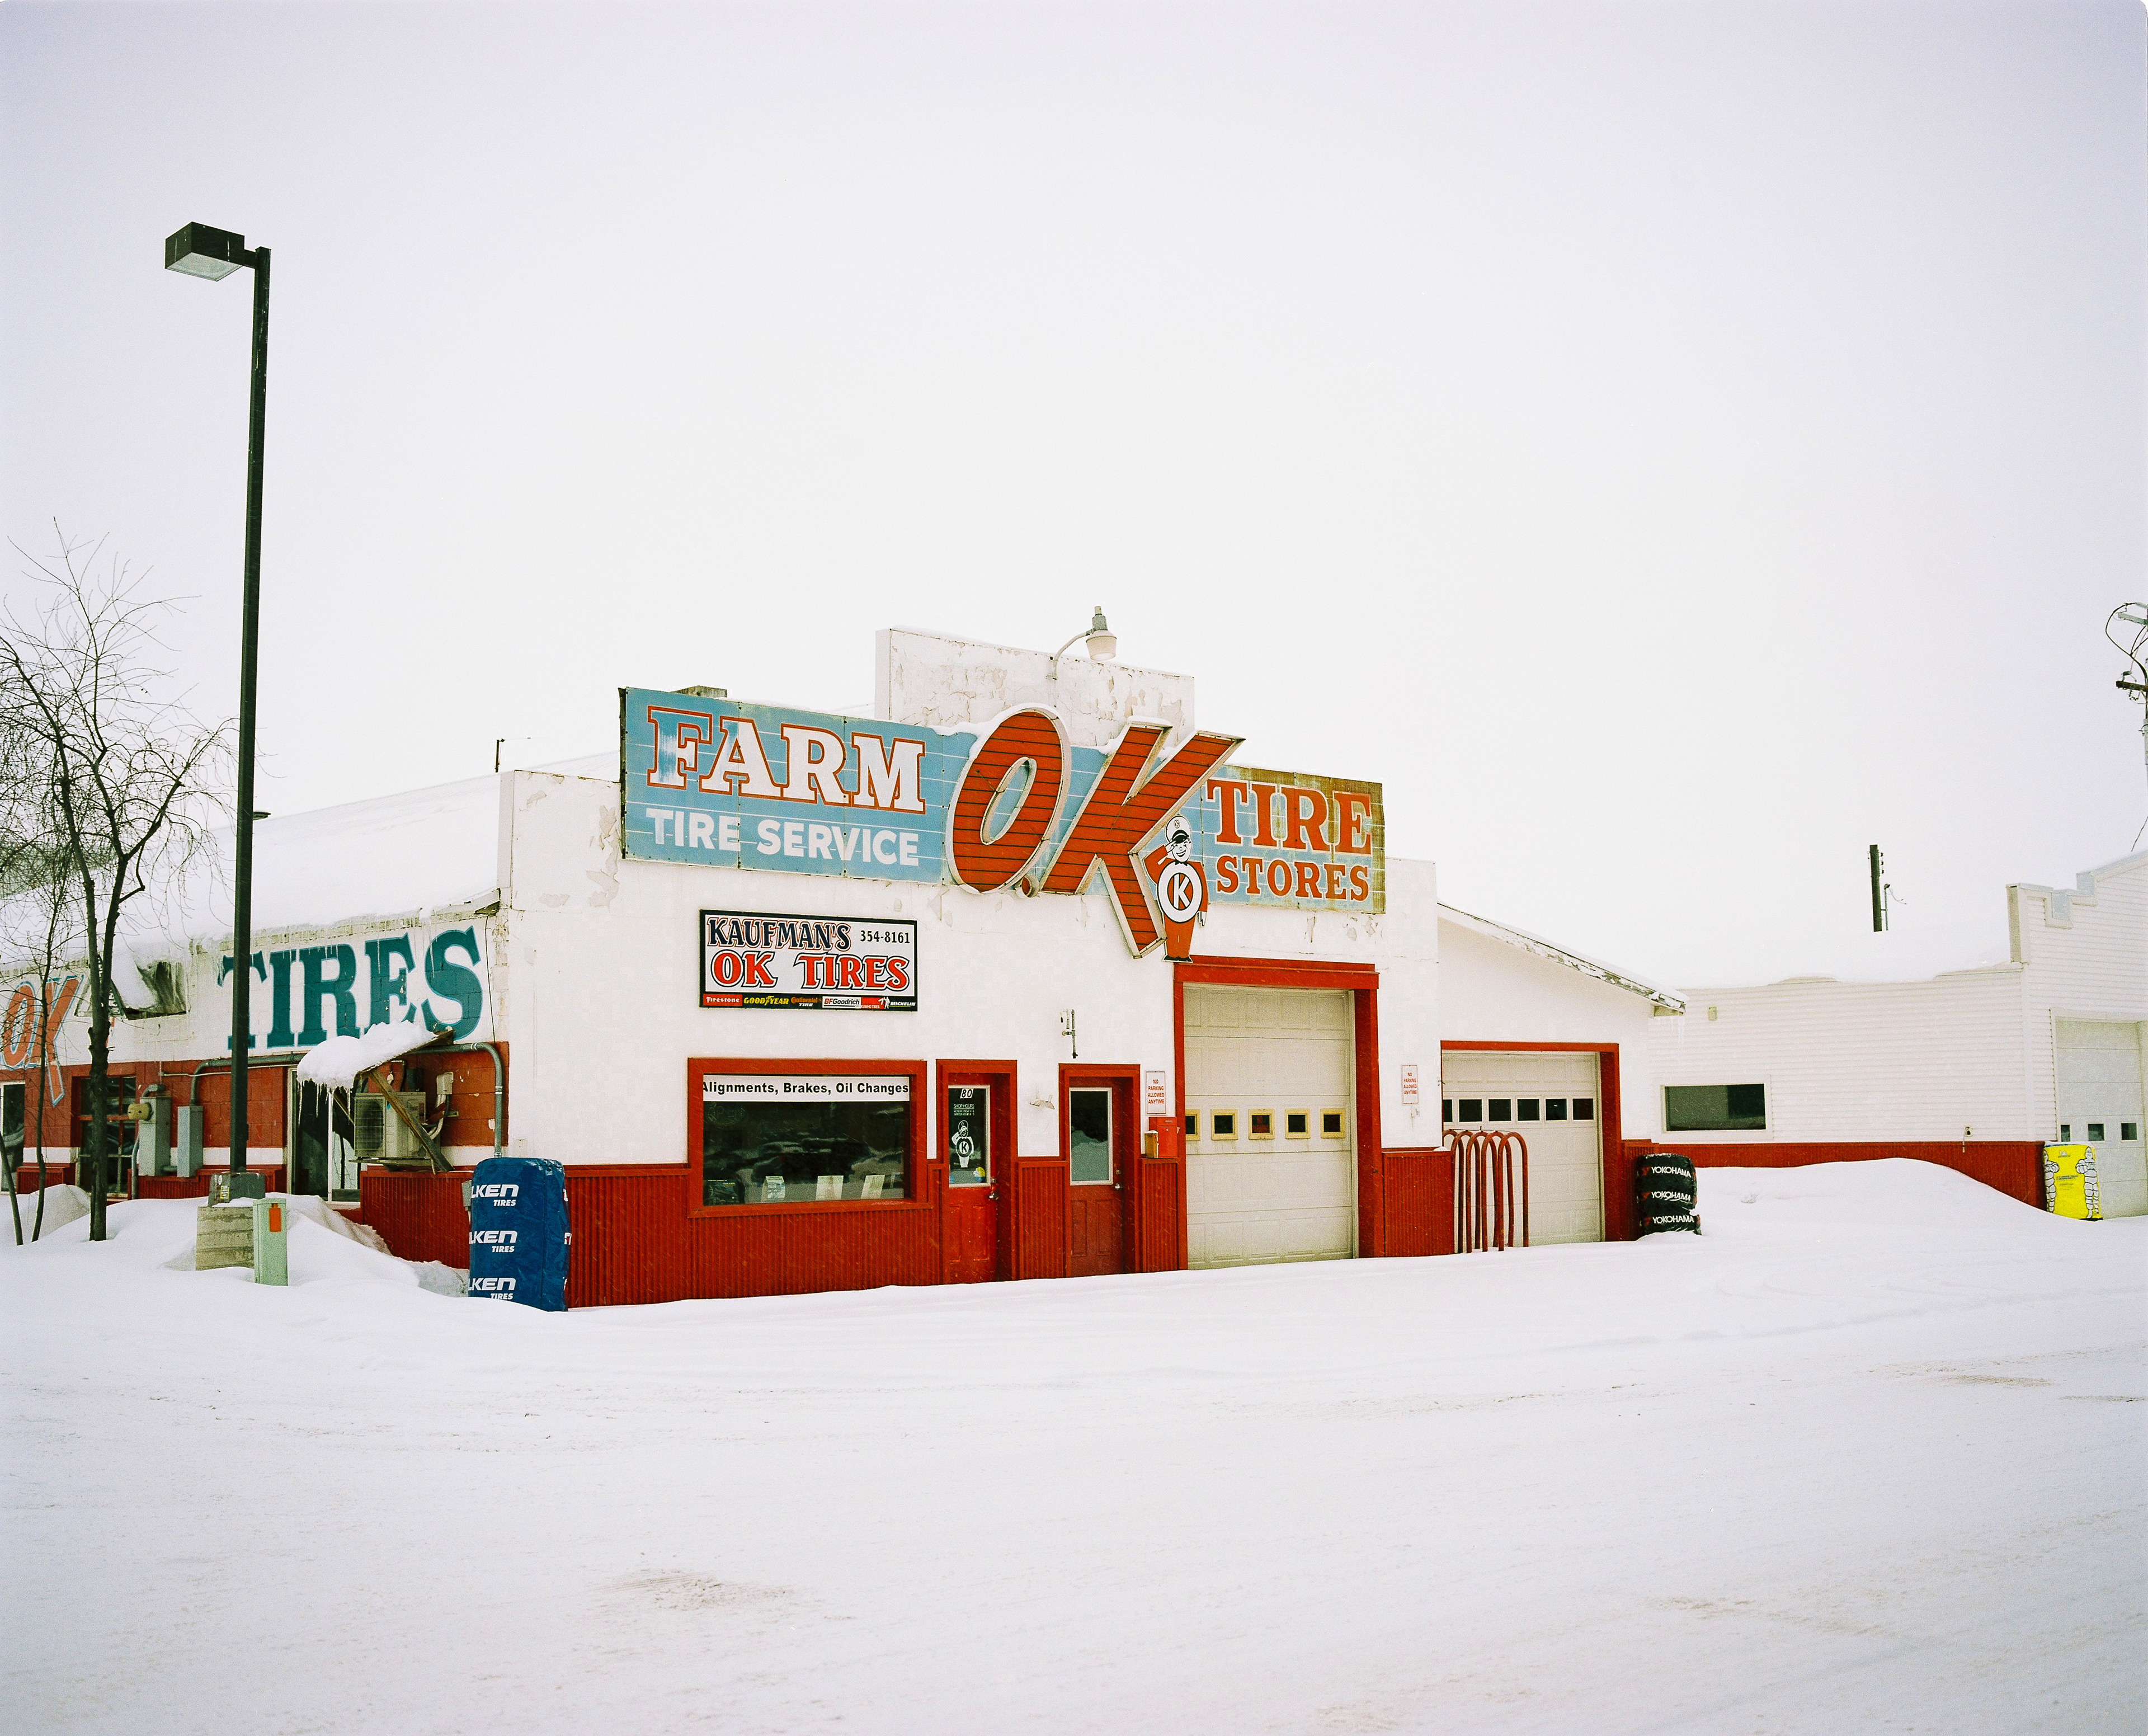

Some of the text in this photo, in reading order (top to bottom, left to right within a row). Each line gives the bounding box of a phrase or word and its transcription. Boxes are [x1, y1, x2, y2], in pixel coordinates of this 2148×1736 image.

[647, 705, 925, 815] FARM
[1206, 779, 1372, 855] TIRE
[646, 808, 919, 866] TIRE SERVICE
[1216, 855, 1369, 902] STORES
[707, 918, 910, 951] KAUFMAN'S 354-8161
[217, 926, 483, 1051] TIRES
[710, 949, 910, 992] OK TIRES
[743, 996, 789, 1005] GOODYEAR
[1, 974, 84, 1107] OK
[703, 1082, 909, 1095] Alignments, Brakes, Oil Changes
[962, 1089, 972, 1098] 80
[1651, 1166, 1692, 1178] YOKOHAMA
[1651, 1191, 1690, 1202] YOKOHAMA
[1652, 1215, 1694, 1224] YOKOHAMA
